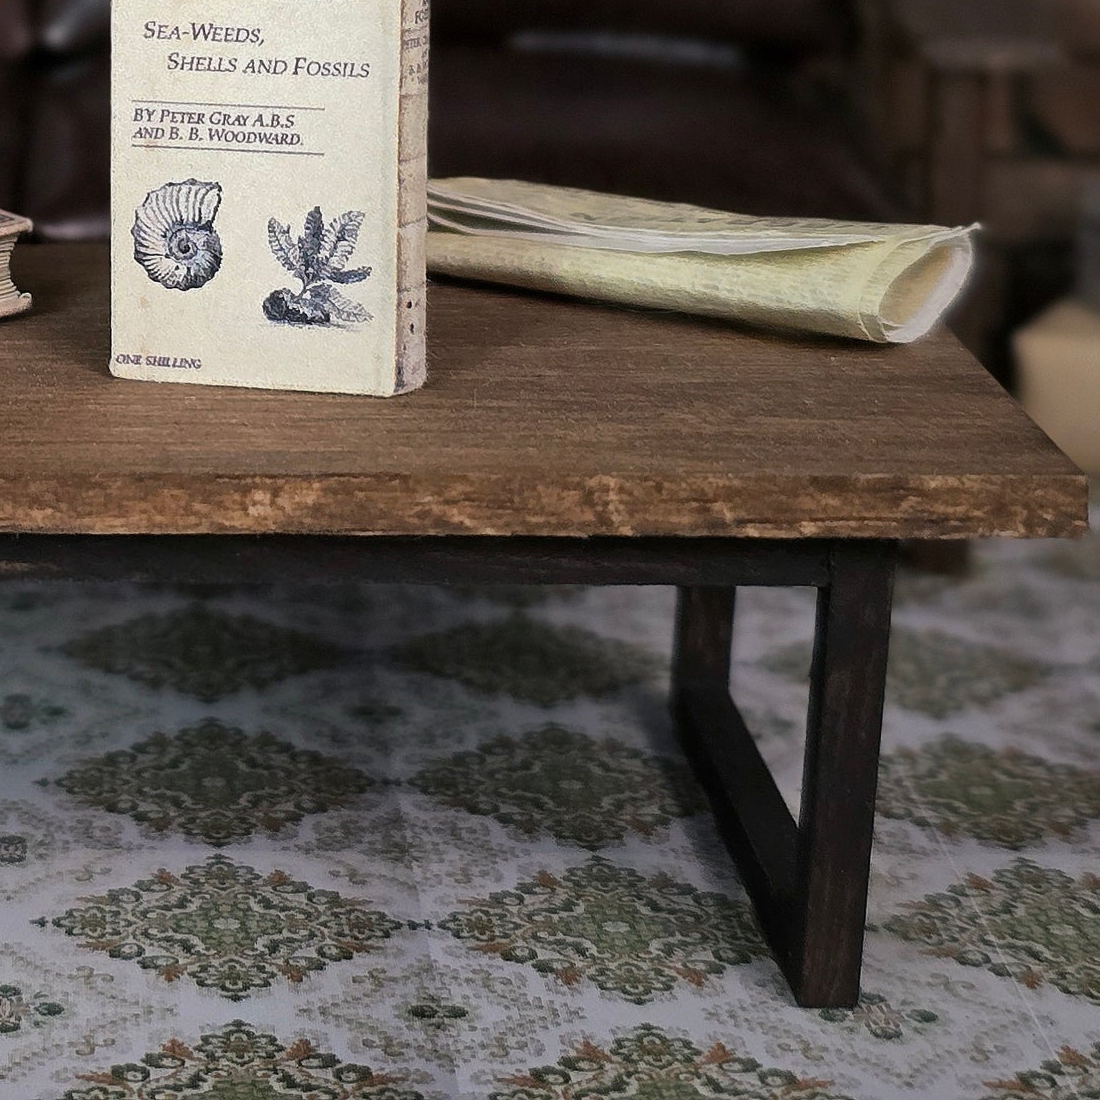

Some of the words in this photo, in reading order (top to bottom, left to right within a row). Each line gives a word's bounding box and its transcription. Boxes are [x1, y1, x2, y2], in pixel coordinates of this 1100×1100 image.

[167, 52, 238, 73] SHELLS
[242, 57, 288, 76] AND
[292, 57, 371, 79] FOSSILS
[133, 108, 156, 122] BY
[159, 109, 205, 125] PETER
[209, 111, 250, 128] GRAY
[132, 126, 165, 140] AND
[168, 127, 184, 141] B.
[188, 127, 204, 142] B.
[116, 354, 142, 365] ONE
[145, 355, 202, 370] SHILLING
